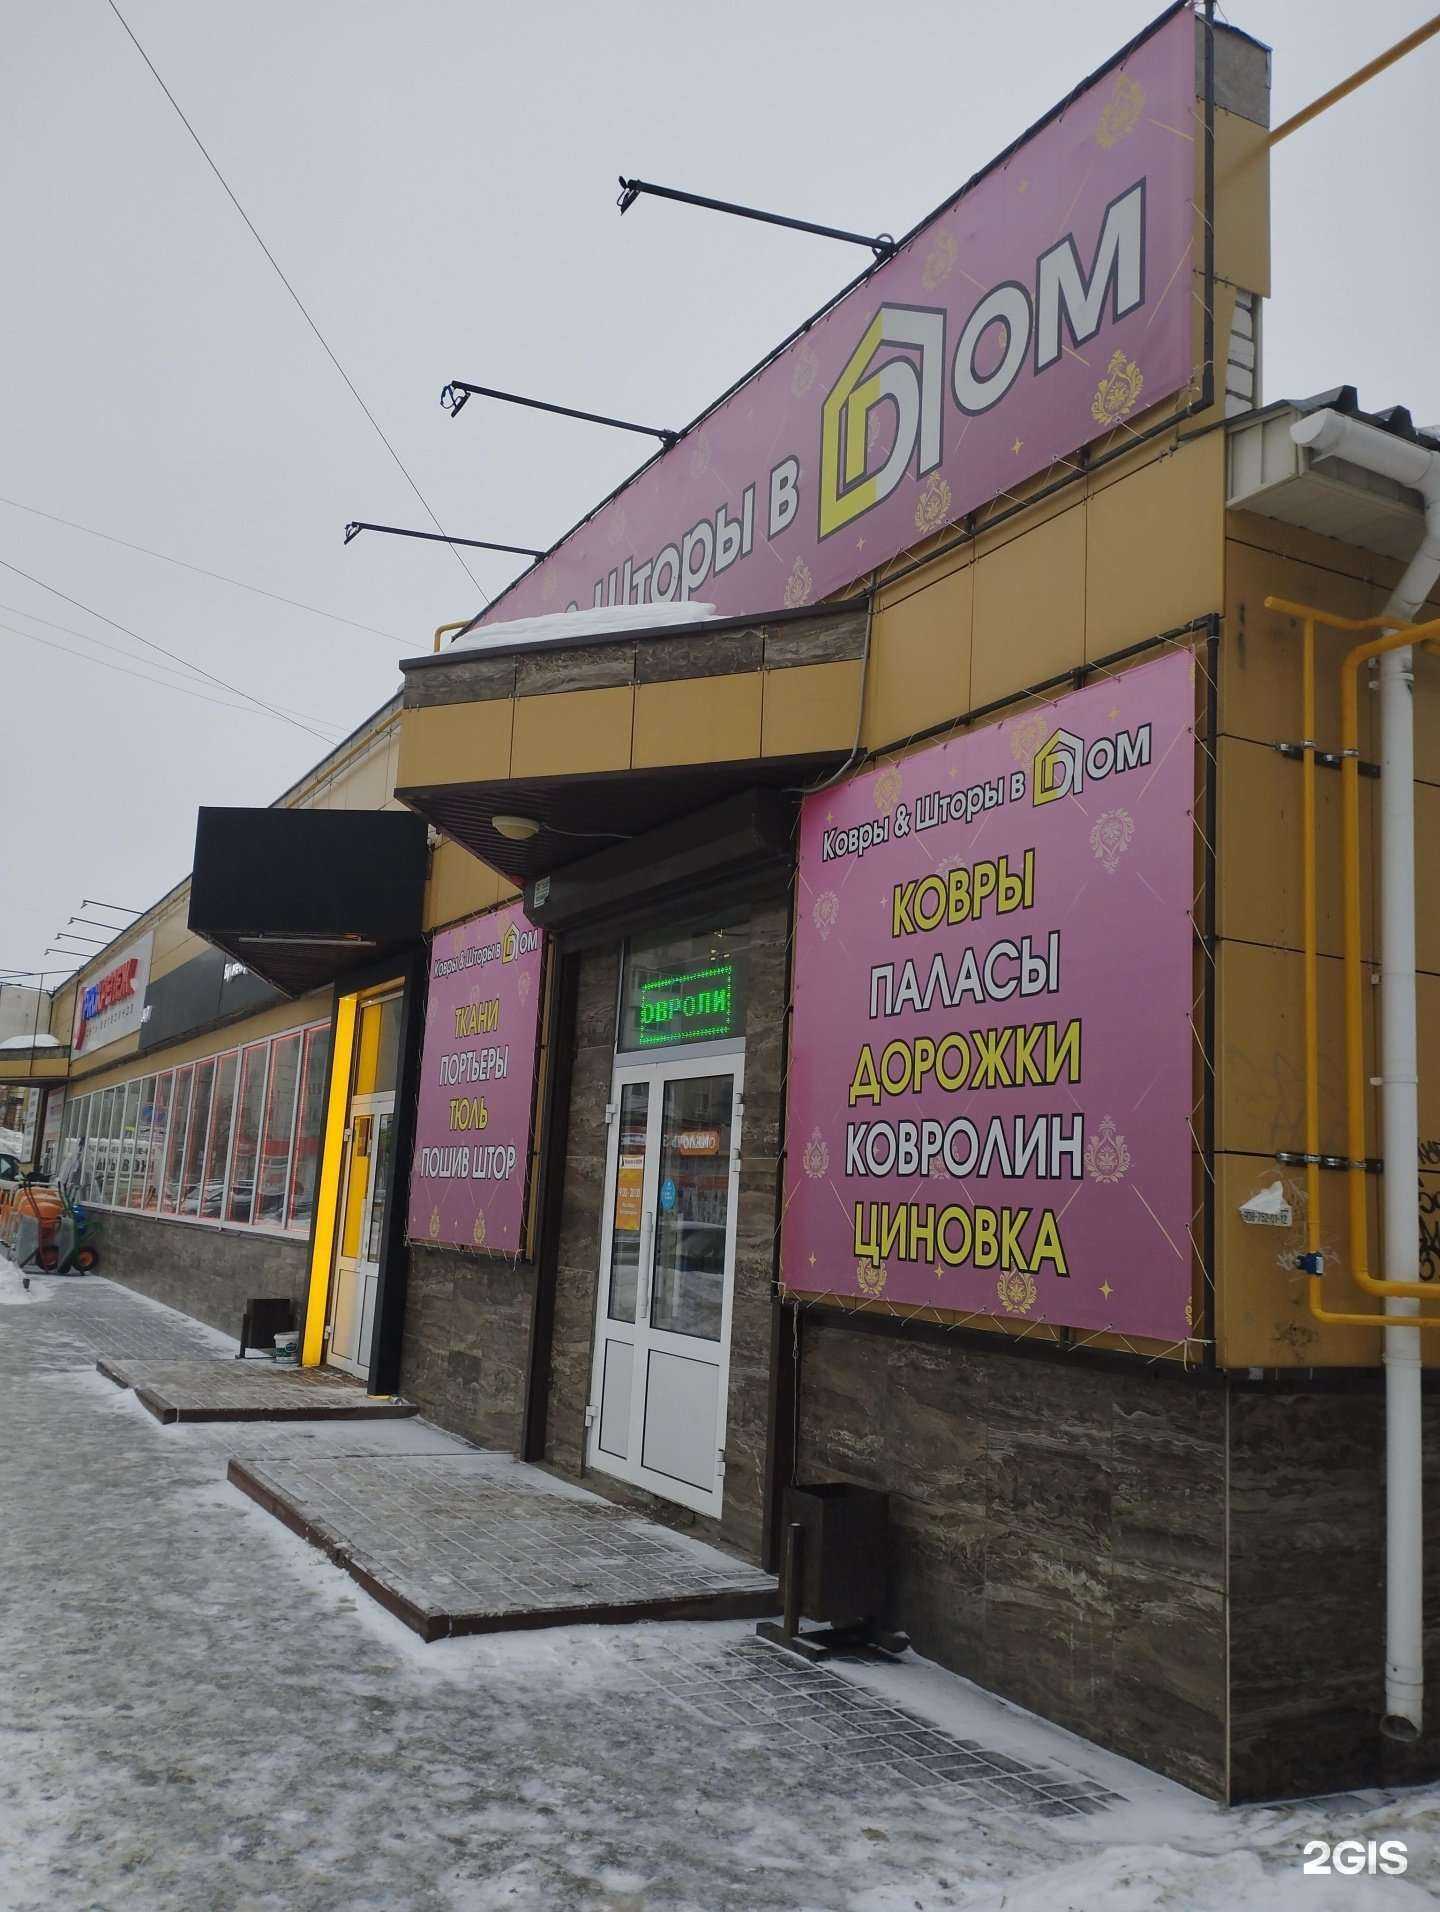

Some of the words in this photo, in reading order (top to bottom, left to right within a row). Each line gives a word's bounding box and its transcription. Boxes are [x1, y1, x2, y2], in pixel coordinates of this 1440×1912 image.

[822, 817, 889, 861] Ковры
[894, 804, 913, 838] &
[915, 777, 1005, 832] Шторы
[892, 848, 1035, 938] КОВРЫ
[465, 944, 495, 968] Шторы
[868, 930, 1061, 1019] ПАЛАСЫ
[454, 998, 501, 1040] ТКАНИ
[439, 1046, 509, 1085] ПОРТЬЕРЫ
[848, 1018, 1082, 1107] ДОРОЖКИ
[449, 1095, 489, 1131] ТЮЛЬ
[845, 1113, 1085, 1180] КОВРОЛИН
[420, 1146, 470, 1179] ПОШИВ
[472, 1144, 516, 1180] ШТОР
[853, 1202, 1071, 1277] ЦИНОВКА
